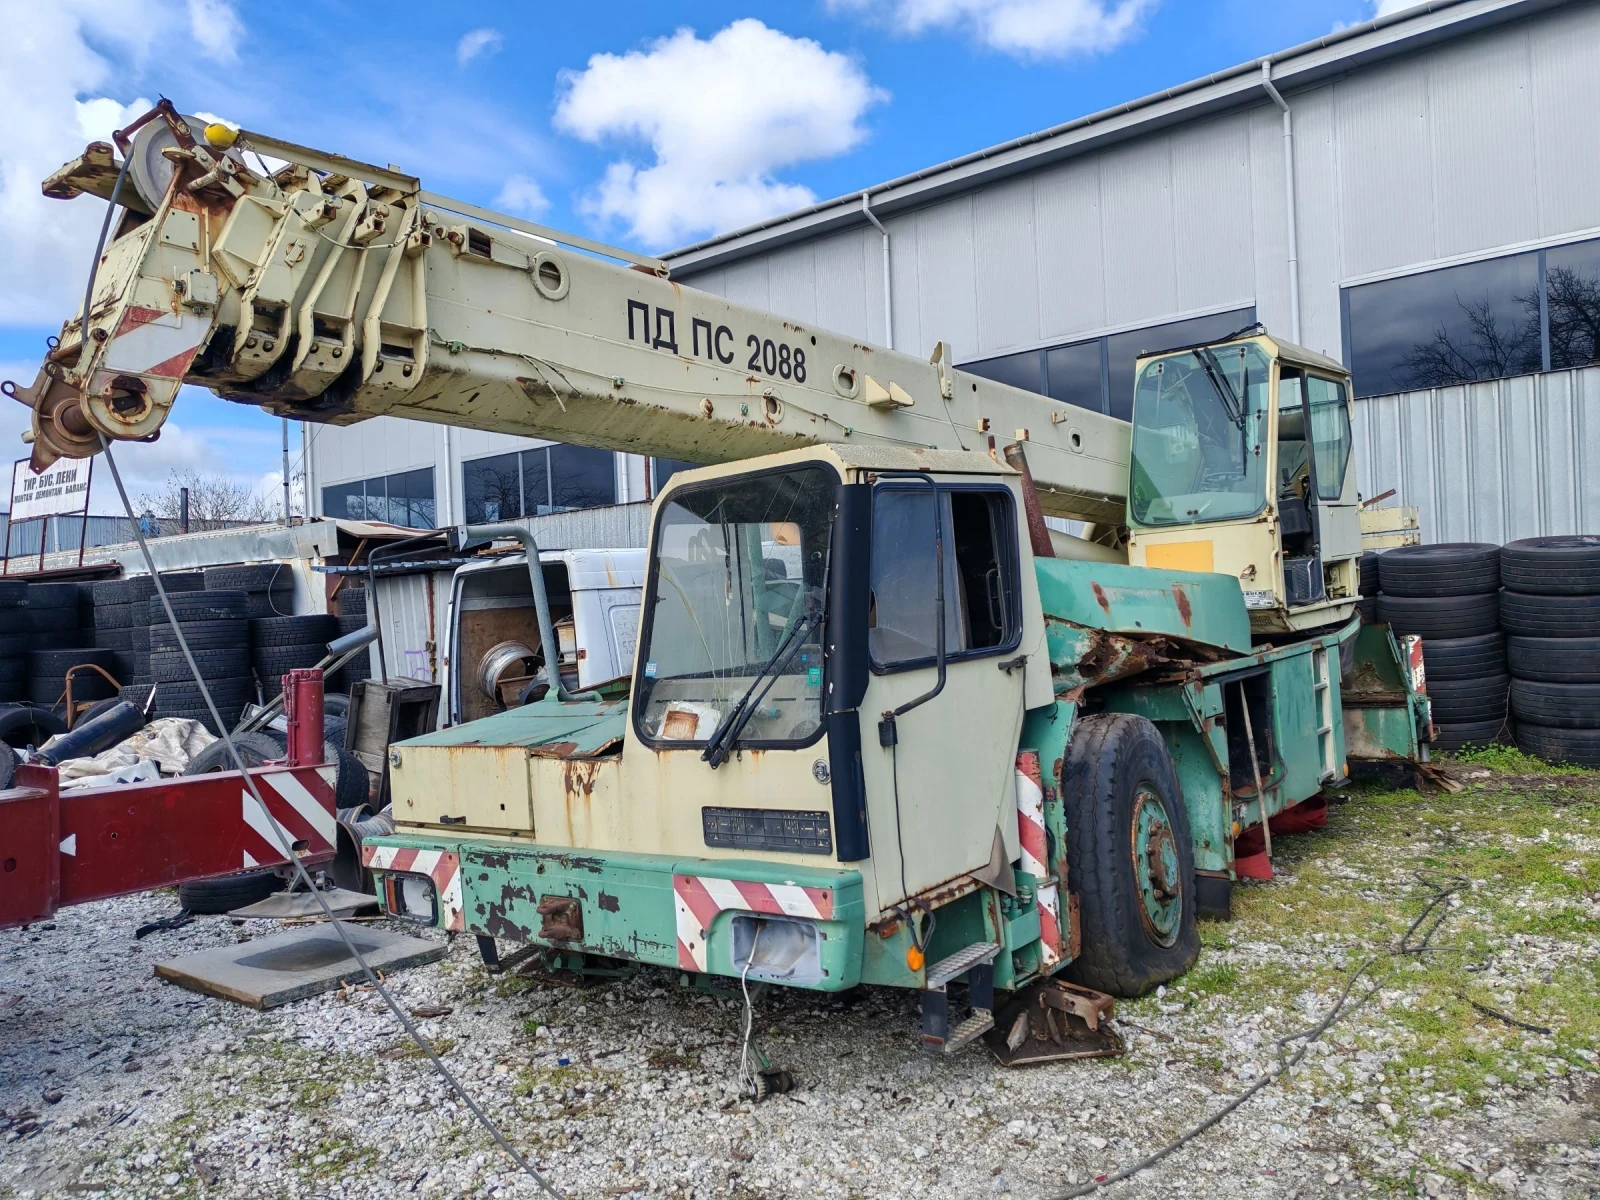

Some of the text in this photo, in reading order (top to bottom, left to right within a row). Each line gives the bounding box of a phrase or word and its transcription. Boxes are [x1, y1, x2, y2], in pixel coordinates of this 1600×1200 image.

[627, 298, 807, 384] ПД ПС 2088
[55, 469, 77, 485] ЛЕКИ
